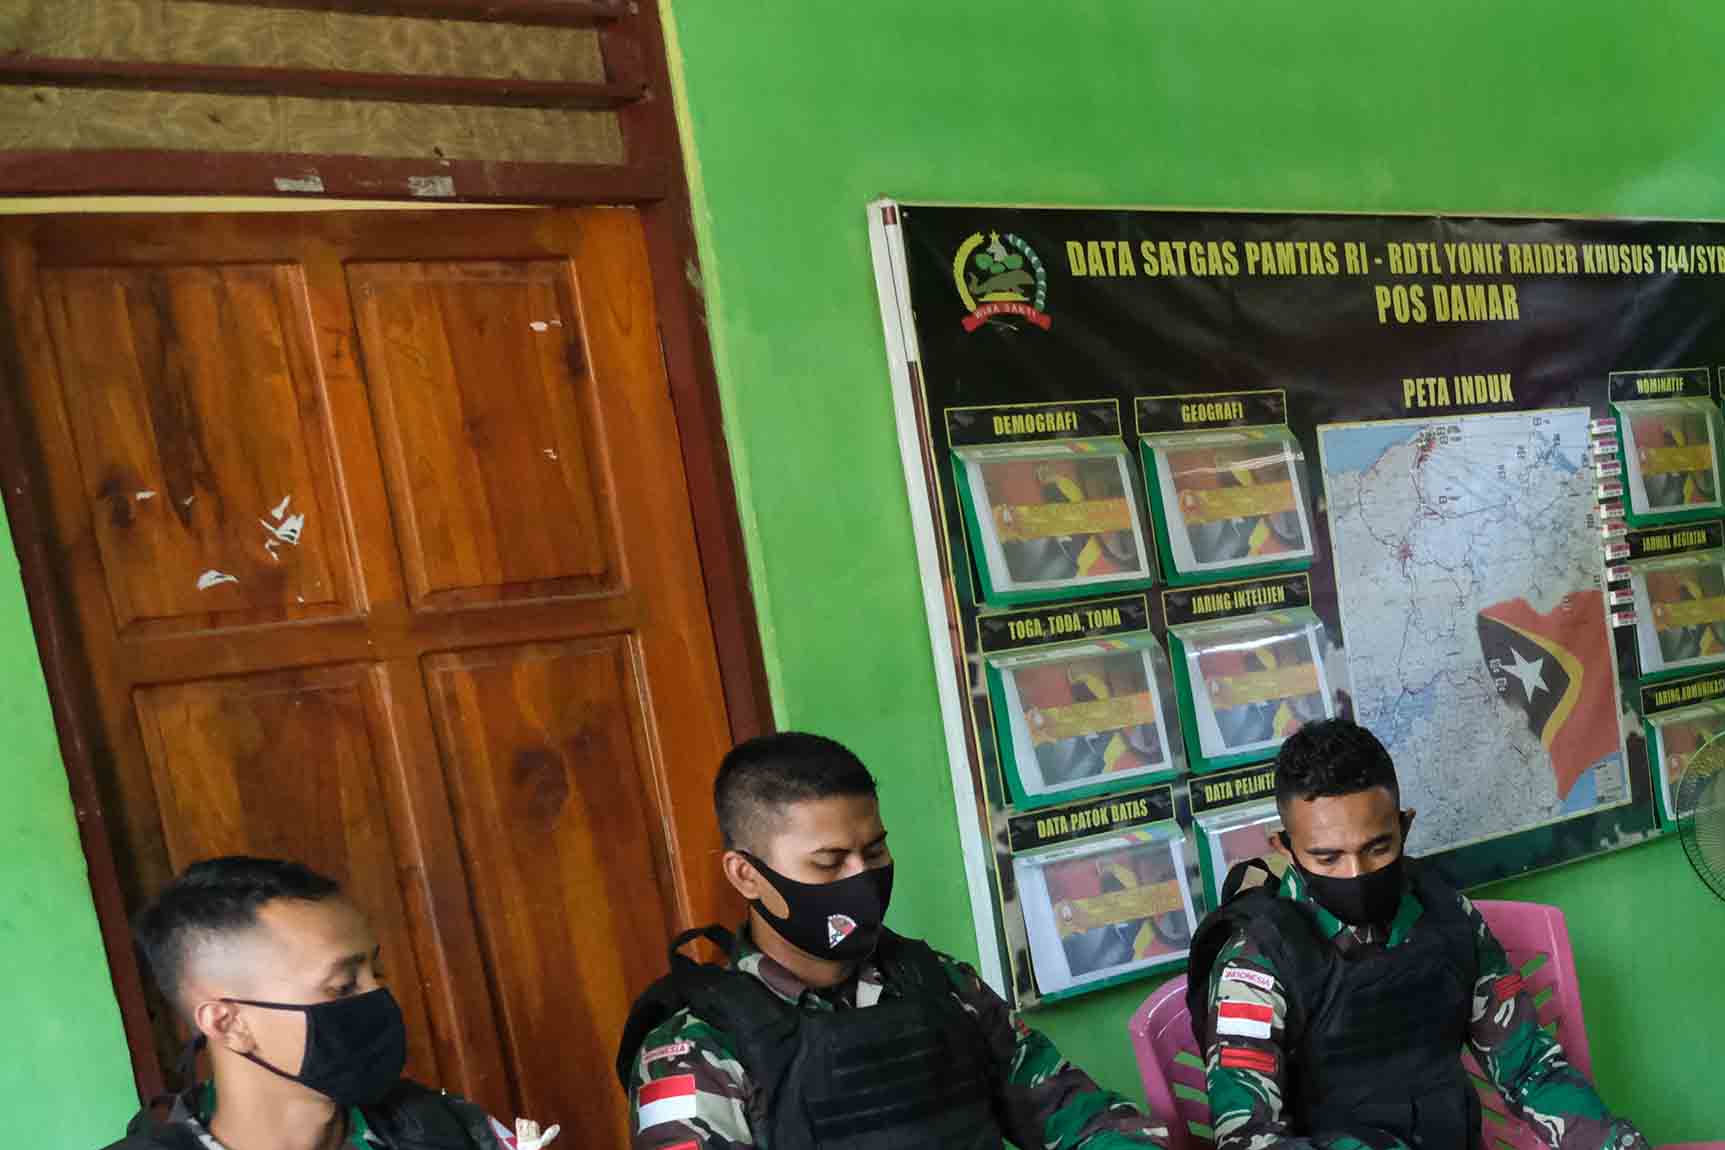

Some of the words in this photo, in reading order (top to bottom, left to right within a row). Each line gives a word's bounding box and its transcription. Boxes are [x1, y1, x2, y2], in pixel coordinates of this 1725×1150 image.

[1066, 240, 1136, 276] DATA
[1140, 240, 1241, 277] SATGAS
[1244, 241, 1340, 276] PAMTAS
[1344, 242, 1368, 275] RI
[1388, 242, 1441, 275] RDTL
[1443, 242, 1504, 275] YONIF
[1508, 243, 1579, 275] RAIDER
[1581, 244, 1654, 275] KHUSUS
[1375, 284, 1427, 323] POS
[1433, 284, 1520, 322] DAMAR
[1403, 377, 1449, 409] PETA
[1454, 374, 1514, 406] INDUK
[992, 412, 1078, 436] DEMOGRAFI
[1181, 400, 1244, 423] GEOGRAFI
[1191, 592, 1232, 615] JARING
[1008, 619, 1045, 640] TOGA,
[1048, 614, 1085, 638] TODA,
[1087, 608, 1121, 629] TOMA
[1204, 782, 1233, 804] DATA
[1234, 769, 1276, 797] PELINT
[1036, 818, 1069, 841] DATA
[1071, 809, 1108, 834] PATOK
